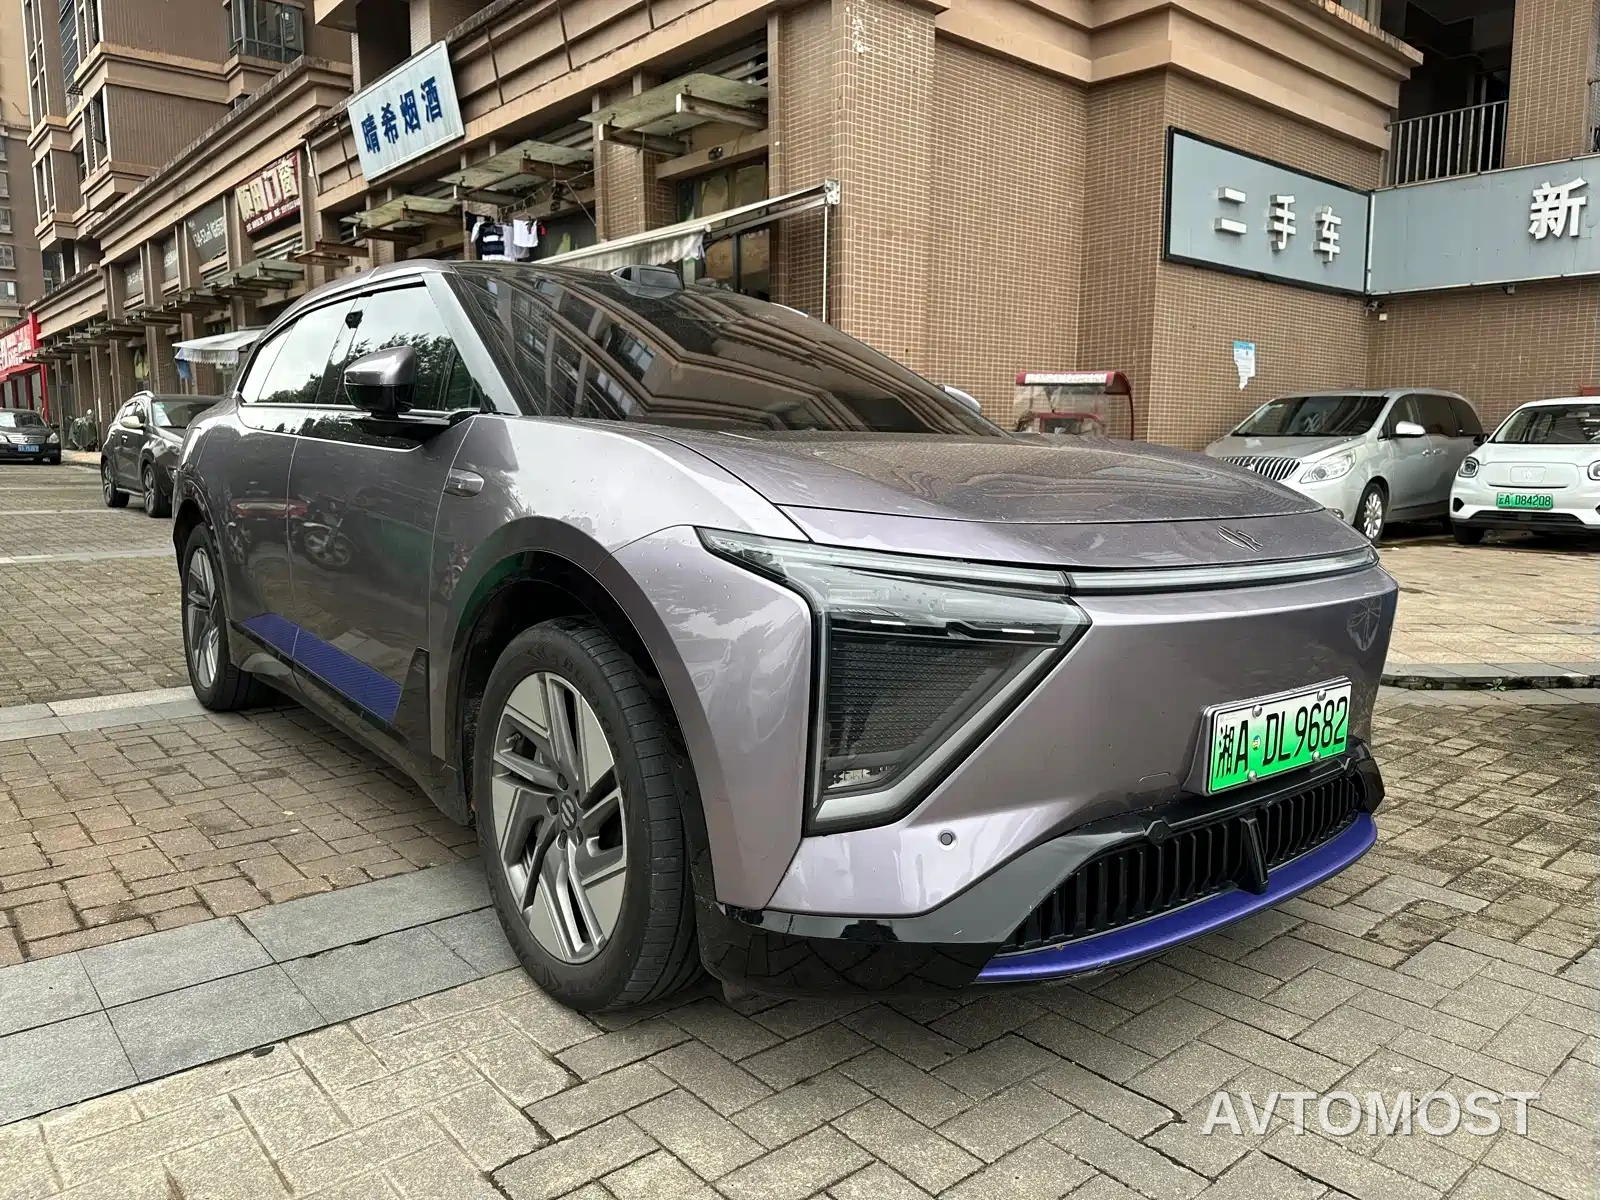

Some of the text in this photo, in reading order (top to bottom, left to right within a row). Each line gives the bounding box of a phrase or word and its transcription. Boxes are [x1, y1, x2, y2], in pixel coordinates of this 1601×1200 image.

[361, 75, 443, 154] 晴希烟酒
[1215, 187, 1342, 264] 二手车
[1528, 176, 1588, 240] 新
[1262, 696, 1348, 767] DL9682
